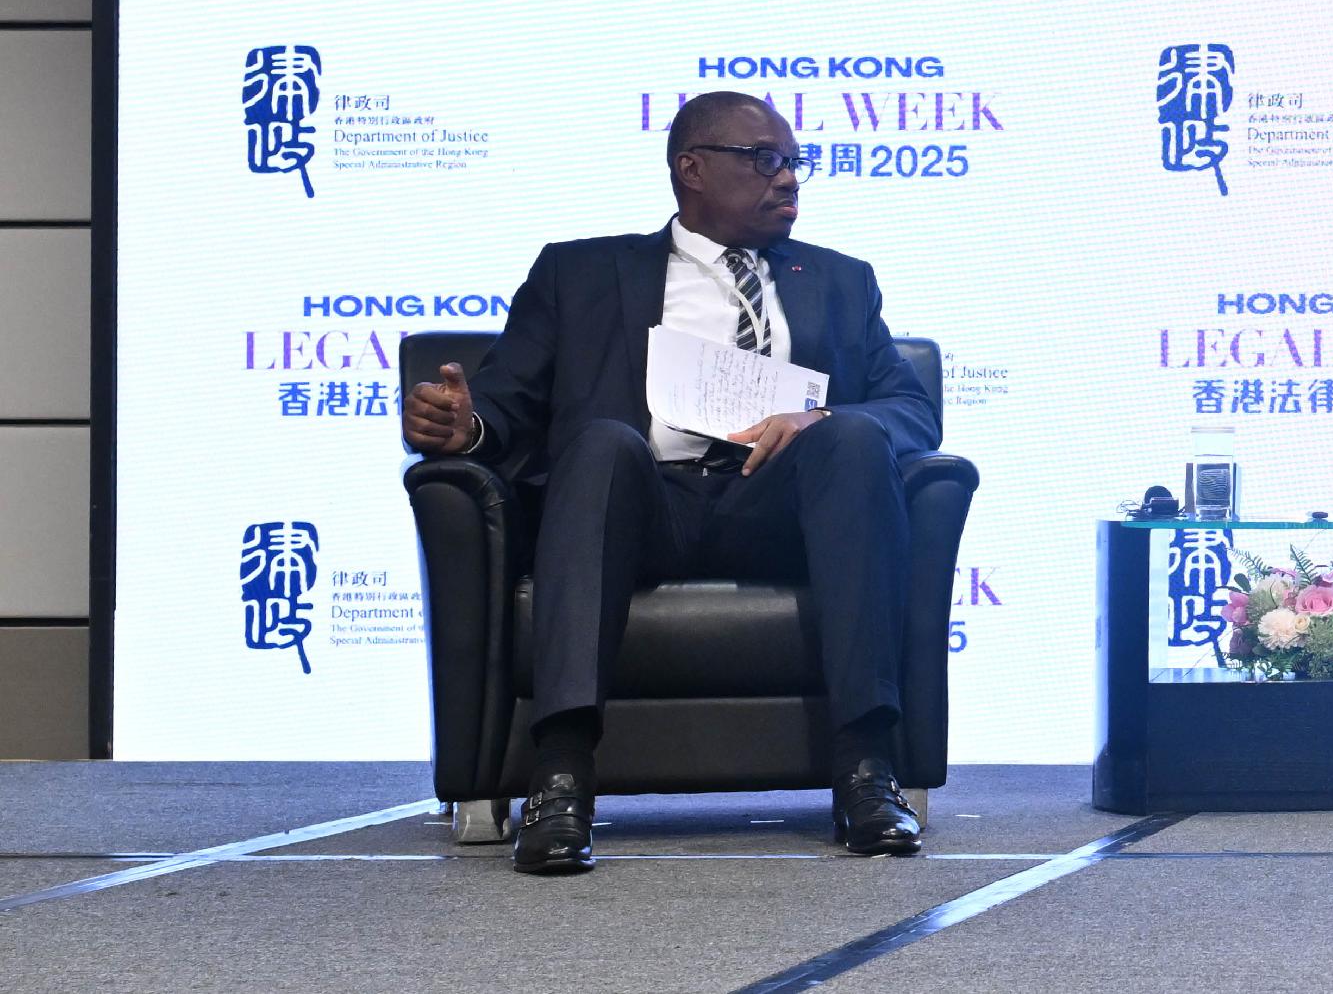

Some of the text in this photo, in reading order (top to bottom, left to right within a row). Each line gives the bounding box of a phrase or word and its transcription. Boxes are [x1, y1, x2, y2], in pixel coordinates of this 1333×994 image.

[697, 55, 946, 80] HONG KONG
[334, 94, 390, 111] 律政司
[840, 91, 1006, 133] WEEK
[333, 129, 489, 146] Department of Justice
[302, 293, 512, 319] HONG KON
[243, 329, 408, 370] LEGA
[332, 570, 388, 587] 律政司
[331, 605, 414, 622] Department
